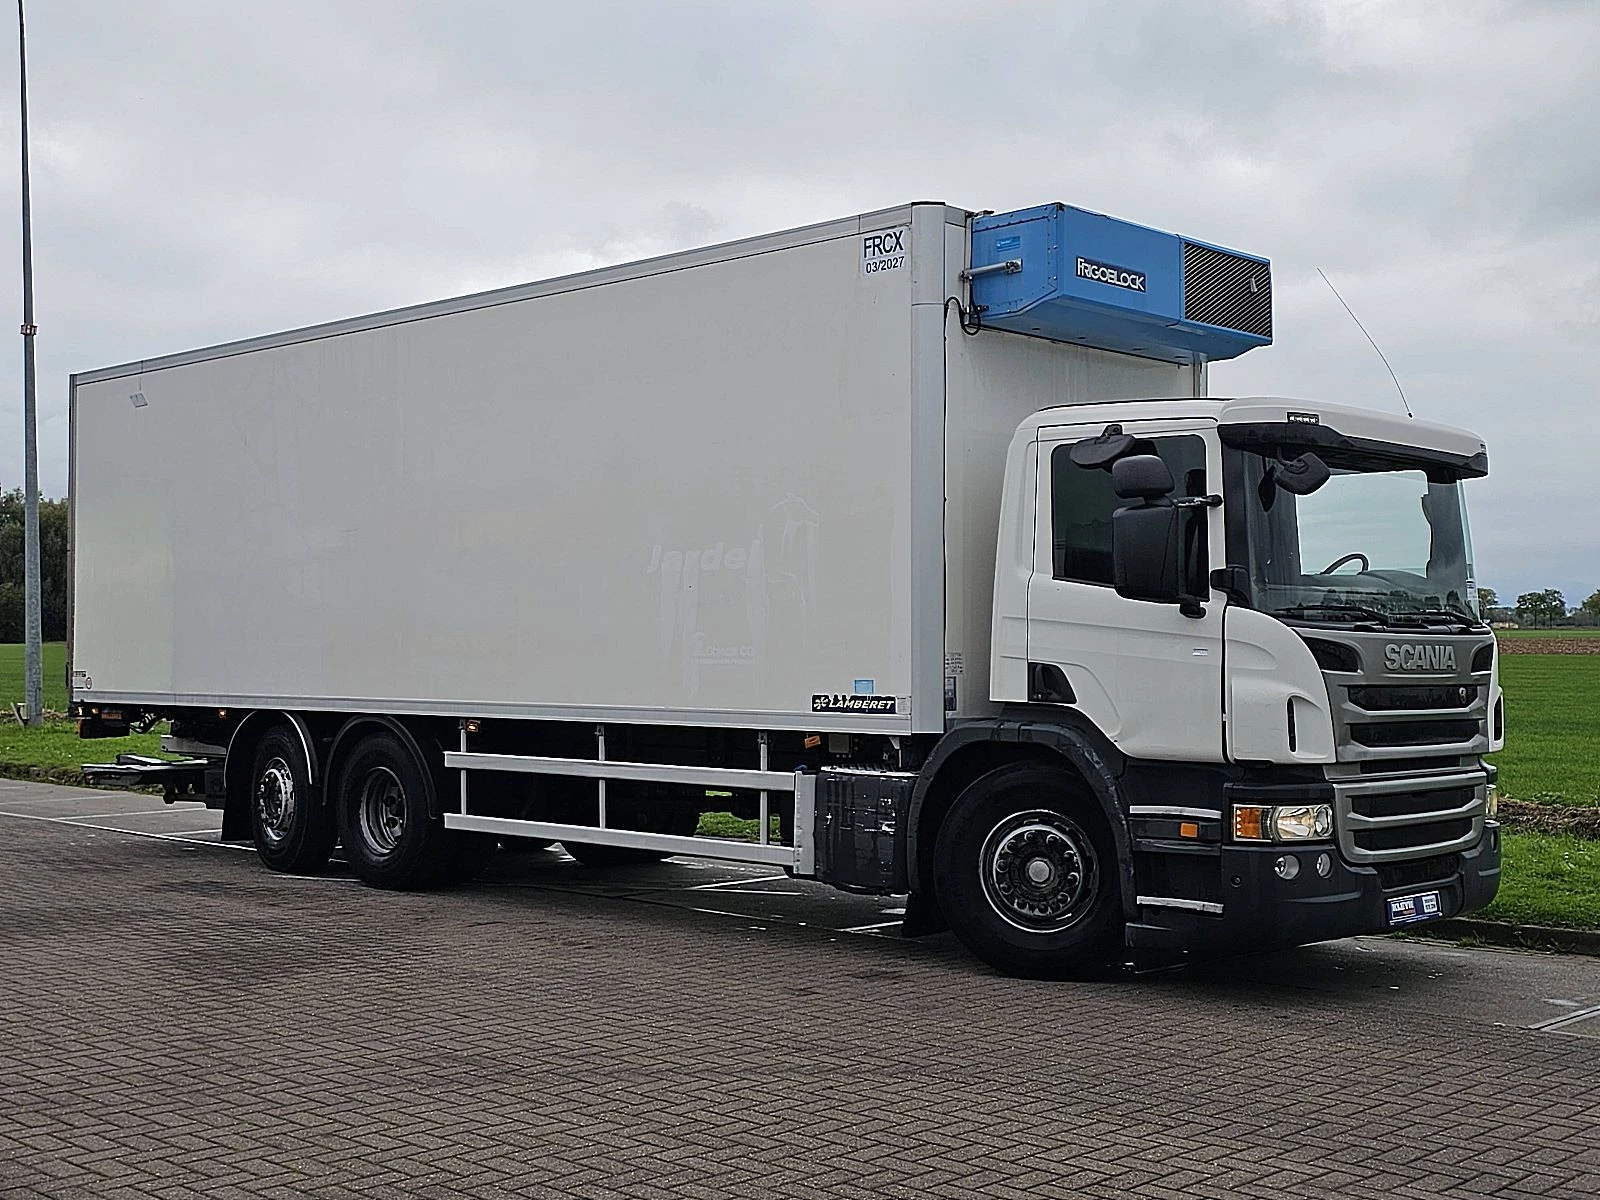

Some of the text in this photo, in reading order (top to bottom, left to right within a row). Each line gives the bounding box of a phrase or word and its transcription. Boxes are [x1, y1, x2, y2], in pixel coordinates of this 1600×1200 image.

[864, 230, 904, 258] FRCX
[866, 256, 905, 274] 03/2027
[1384, 643, 1457, 670] SCANIA
[829, 699, 895, 710] LAMBERET
